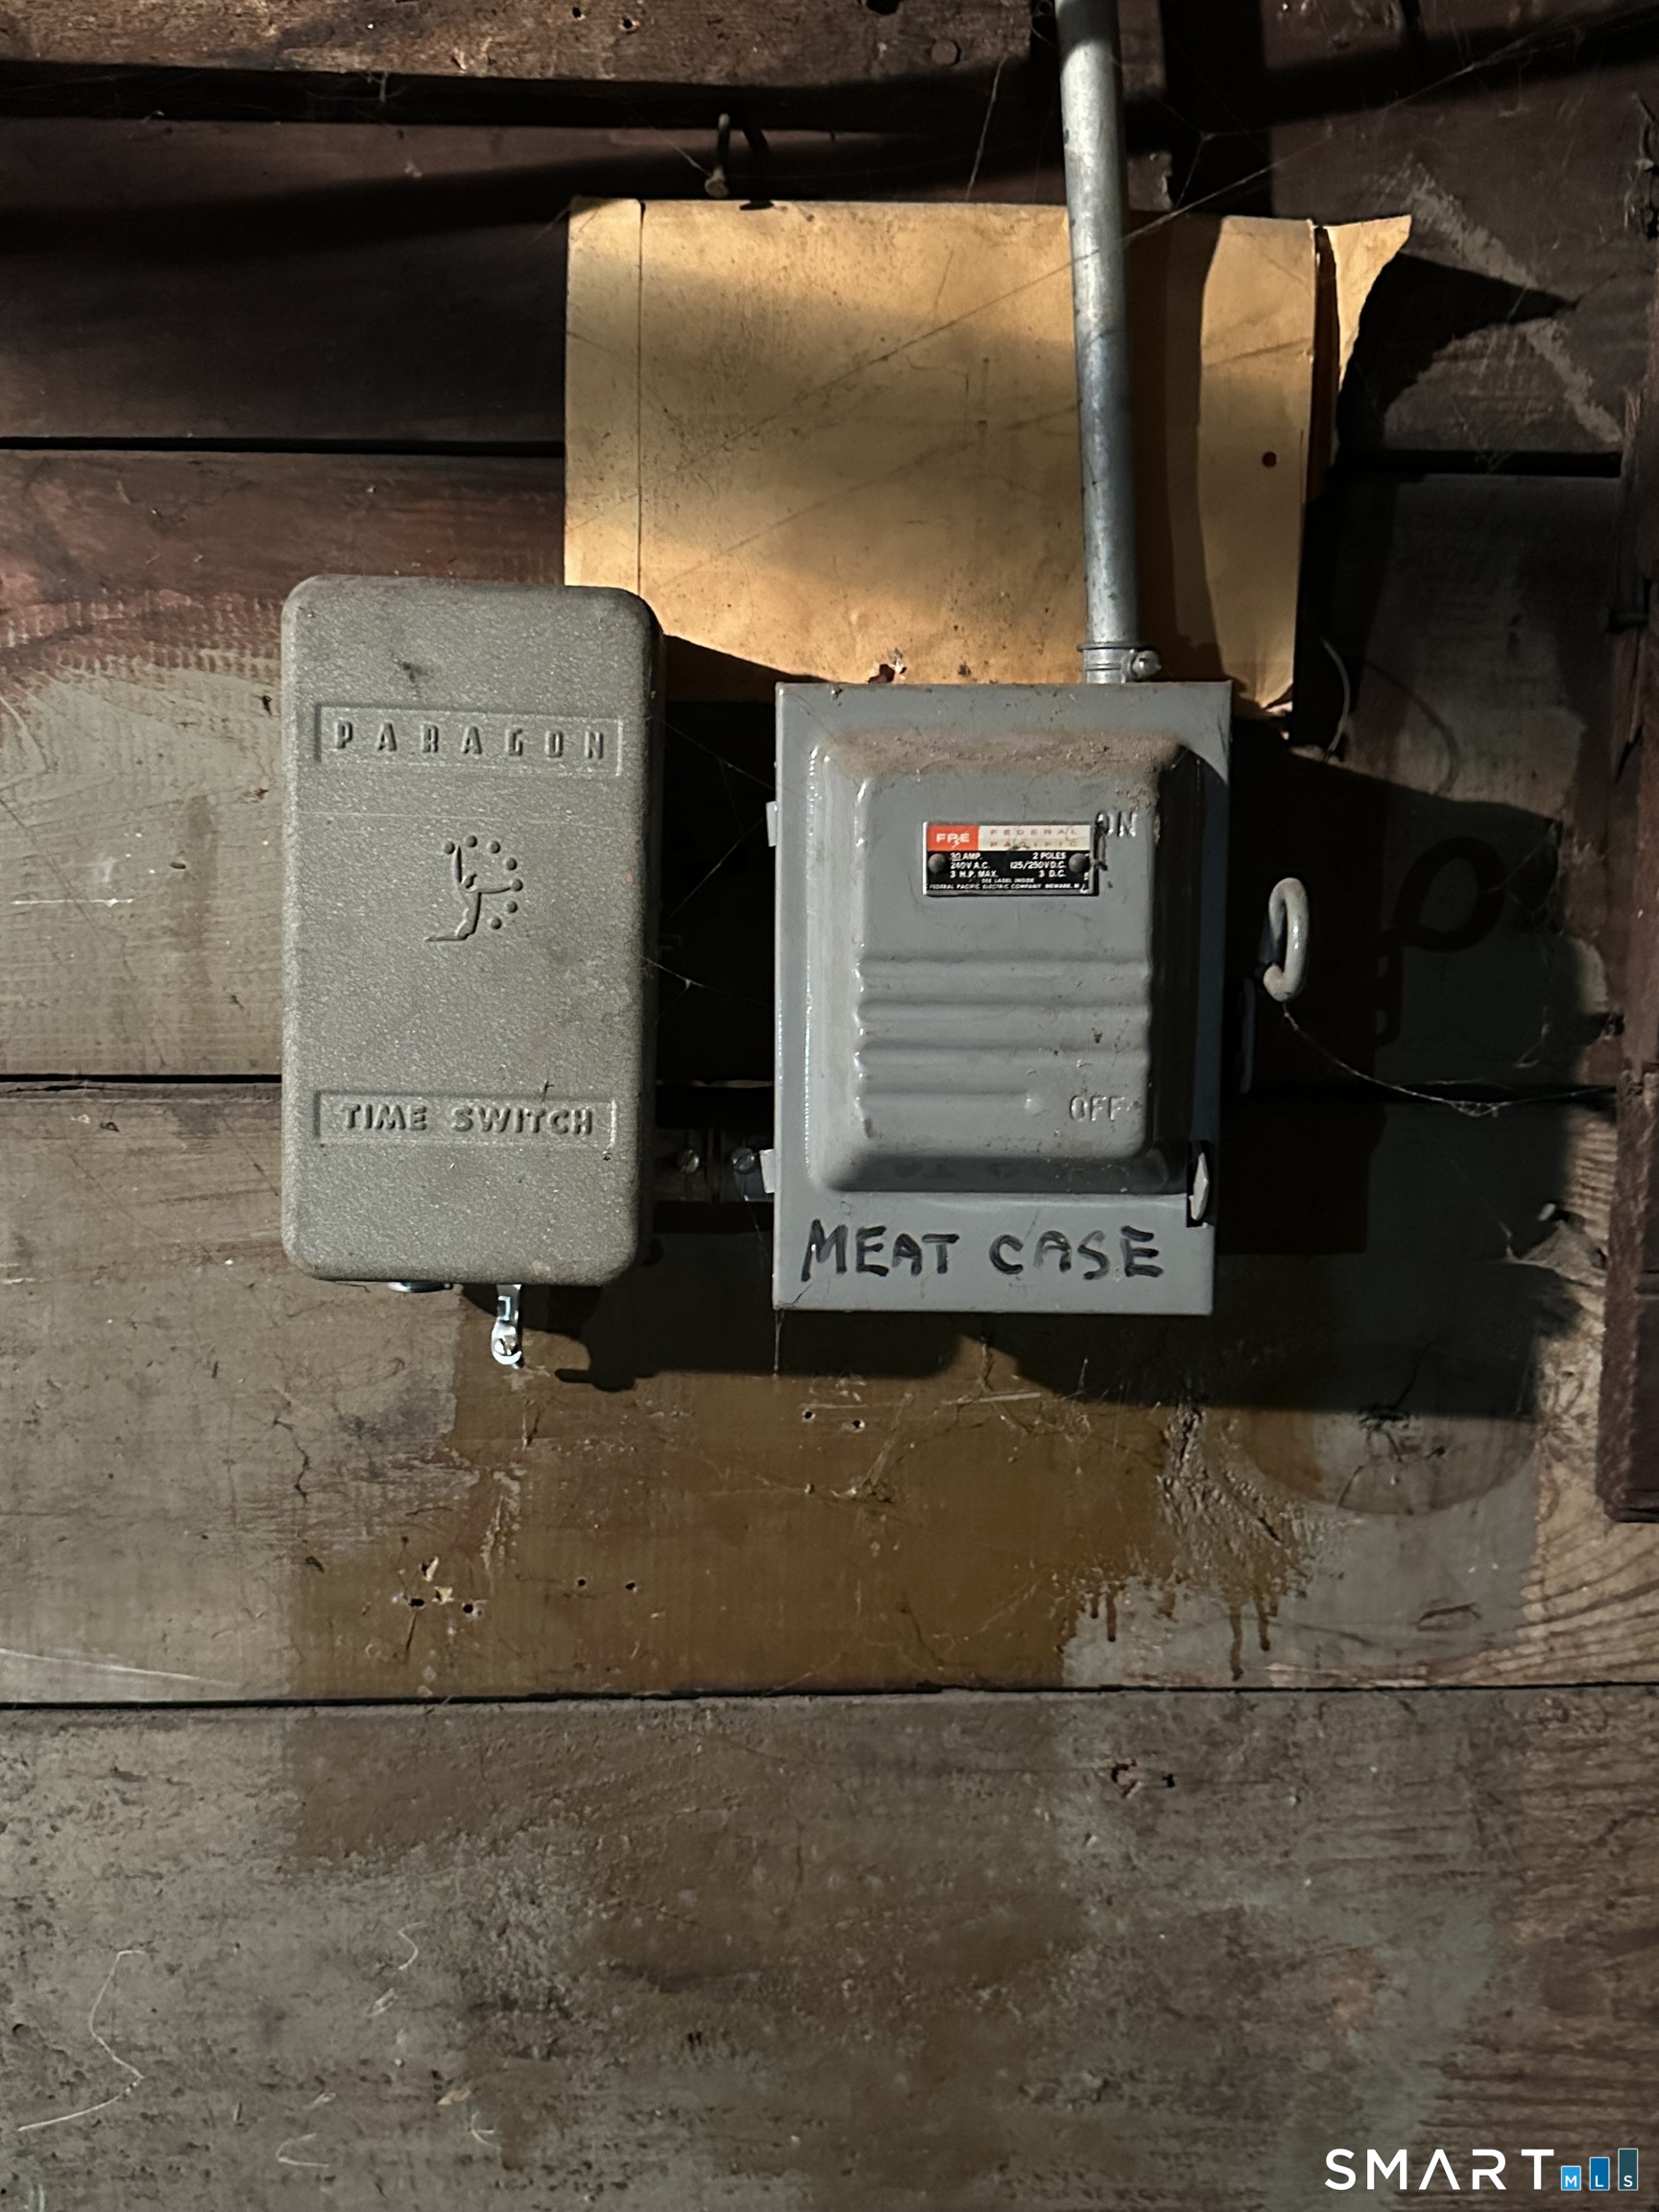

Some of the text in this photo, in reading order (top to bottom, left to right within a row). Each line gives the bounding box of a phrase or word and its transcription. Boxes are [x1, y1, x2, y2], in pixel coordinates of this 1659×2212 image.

[335, 720, 604, 759] PARAGON
[936, 832, 970, 843] FPE
[1032, 852, 1067, 860] 2 POLES
[950, 870, 956, 878] 3
[1038, 869, 1046, 878] 3
[1070, 1094, 1124, 1121] OFF
[342, 1104, 592, 1135] TIME SWITCH
[801, 1218, 1164, 1282] MEAT CASE
